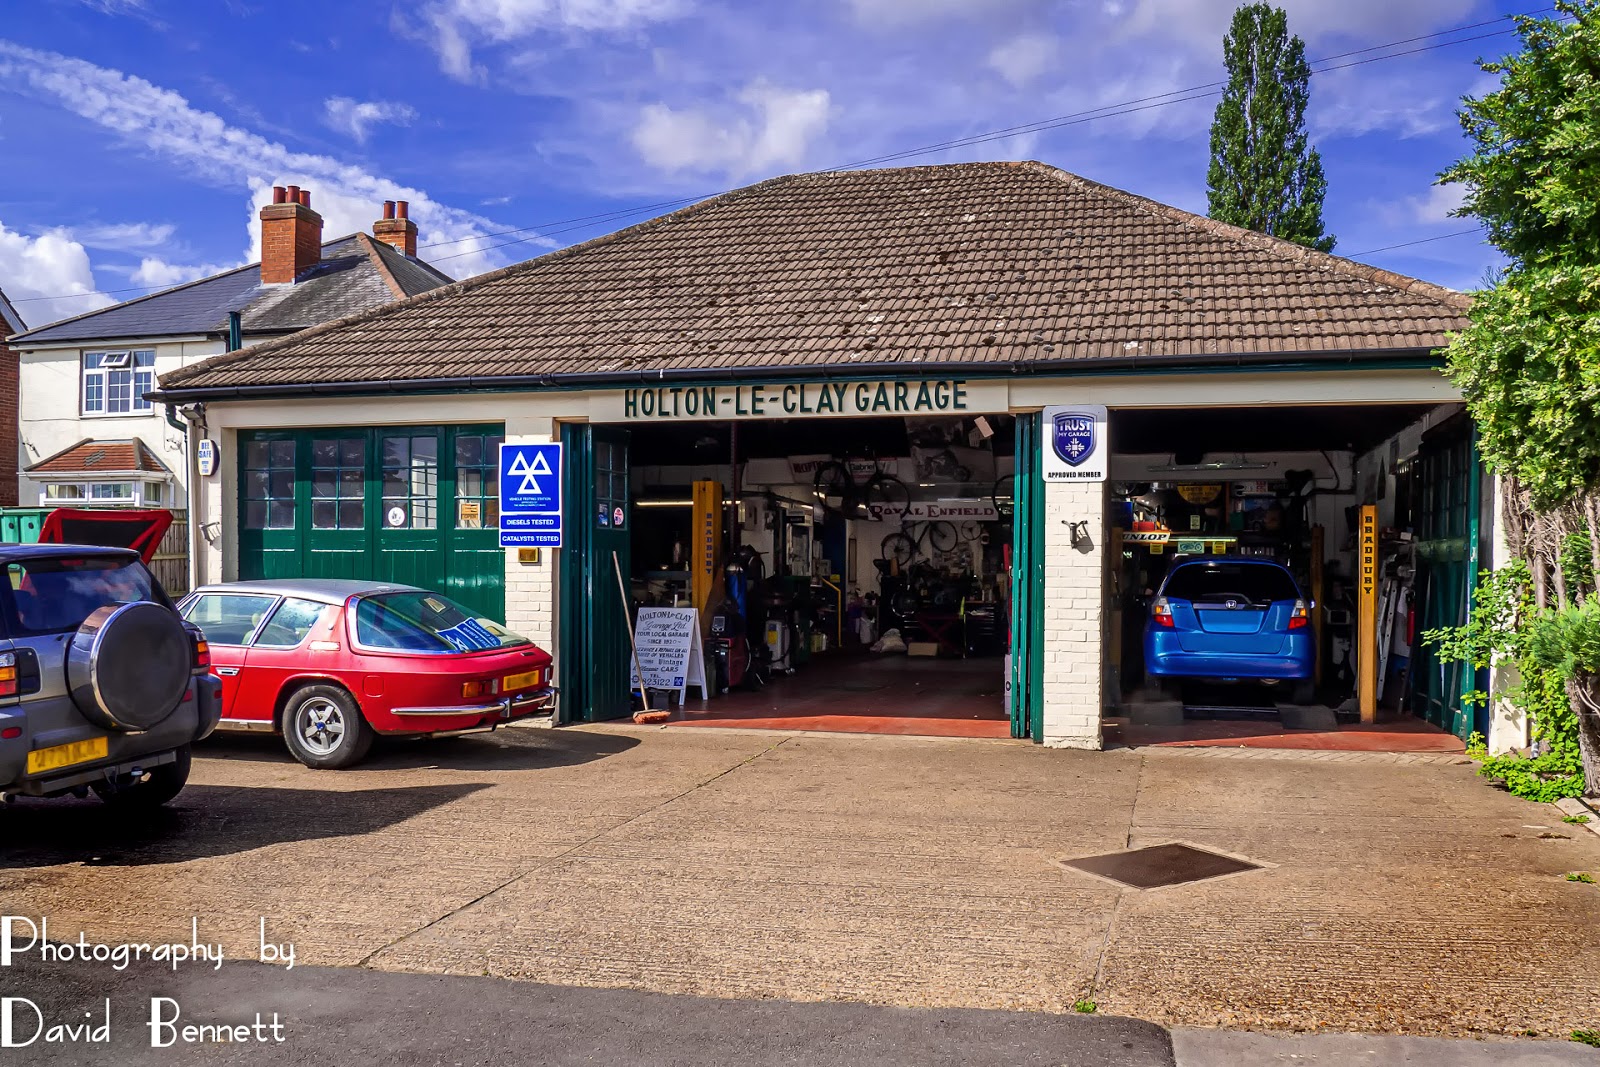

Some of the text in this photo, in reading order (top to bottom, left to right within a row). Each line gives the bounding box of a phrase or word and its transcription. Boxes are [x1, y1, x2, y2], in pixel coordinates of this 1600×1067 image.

[624, 380, 967, 417] HOLTON-LE-CLAY GARAGE
[1058, 420, 1091, 431] TRUST
[198, 450, 212, 459] SAFE
[869, 505, 994, 517] ROYAL ENFIELD
[1123, 533, 1168, 541] UNLOP
[1364, 516, 1373, 594] BRADBURY
[643, 621, 672, 631] Garage
